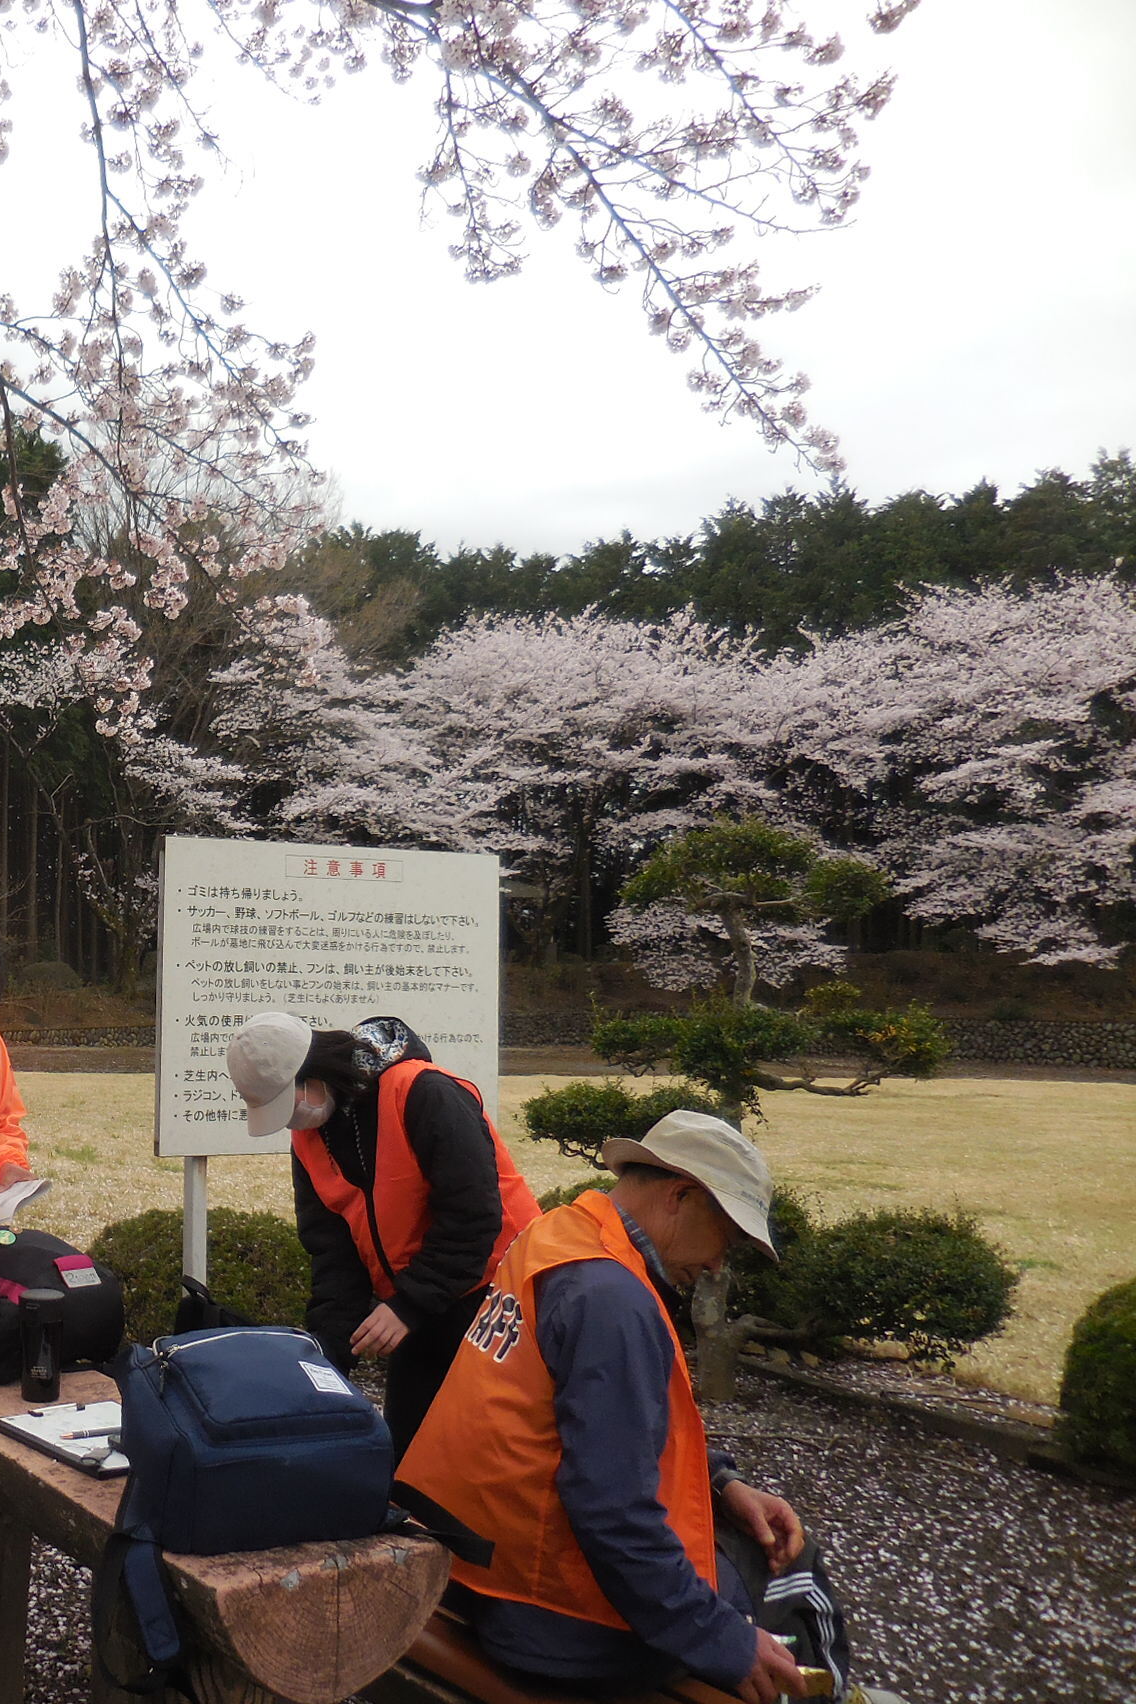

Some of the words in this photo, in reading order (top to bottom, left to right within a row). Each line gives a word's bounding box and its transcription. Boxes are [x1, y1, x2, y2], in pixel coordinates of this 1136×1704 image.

[303, 859, 387, 879] 注意事項
[187, 885, 304, 902] ゴミは持ち帰りましょう。
[190, 1046, 228, 1057] 禁止しま
[184, 1070, 231, 1082] 芝生内へ
